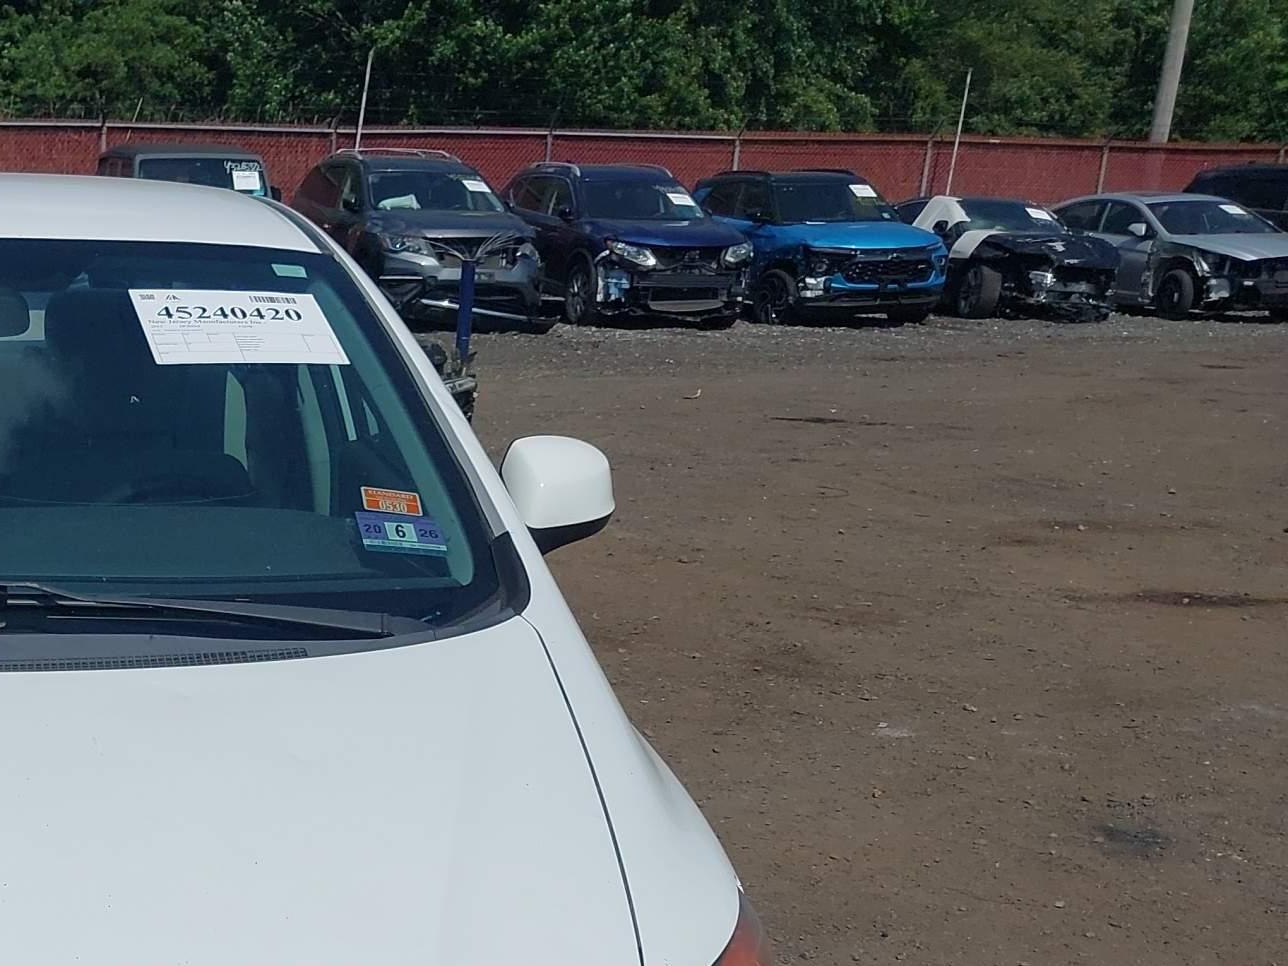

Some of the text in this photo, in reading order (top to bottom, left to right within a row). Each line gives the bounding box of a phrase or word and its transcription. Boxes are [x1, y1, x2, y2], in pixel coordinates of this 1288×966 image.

[157, 305, 302, 322] 45240420
[363, 523, 439, 539] 20 6 26
